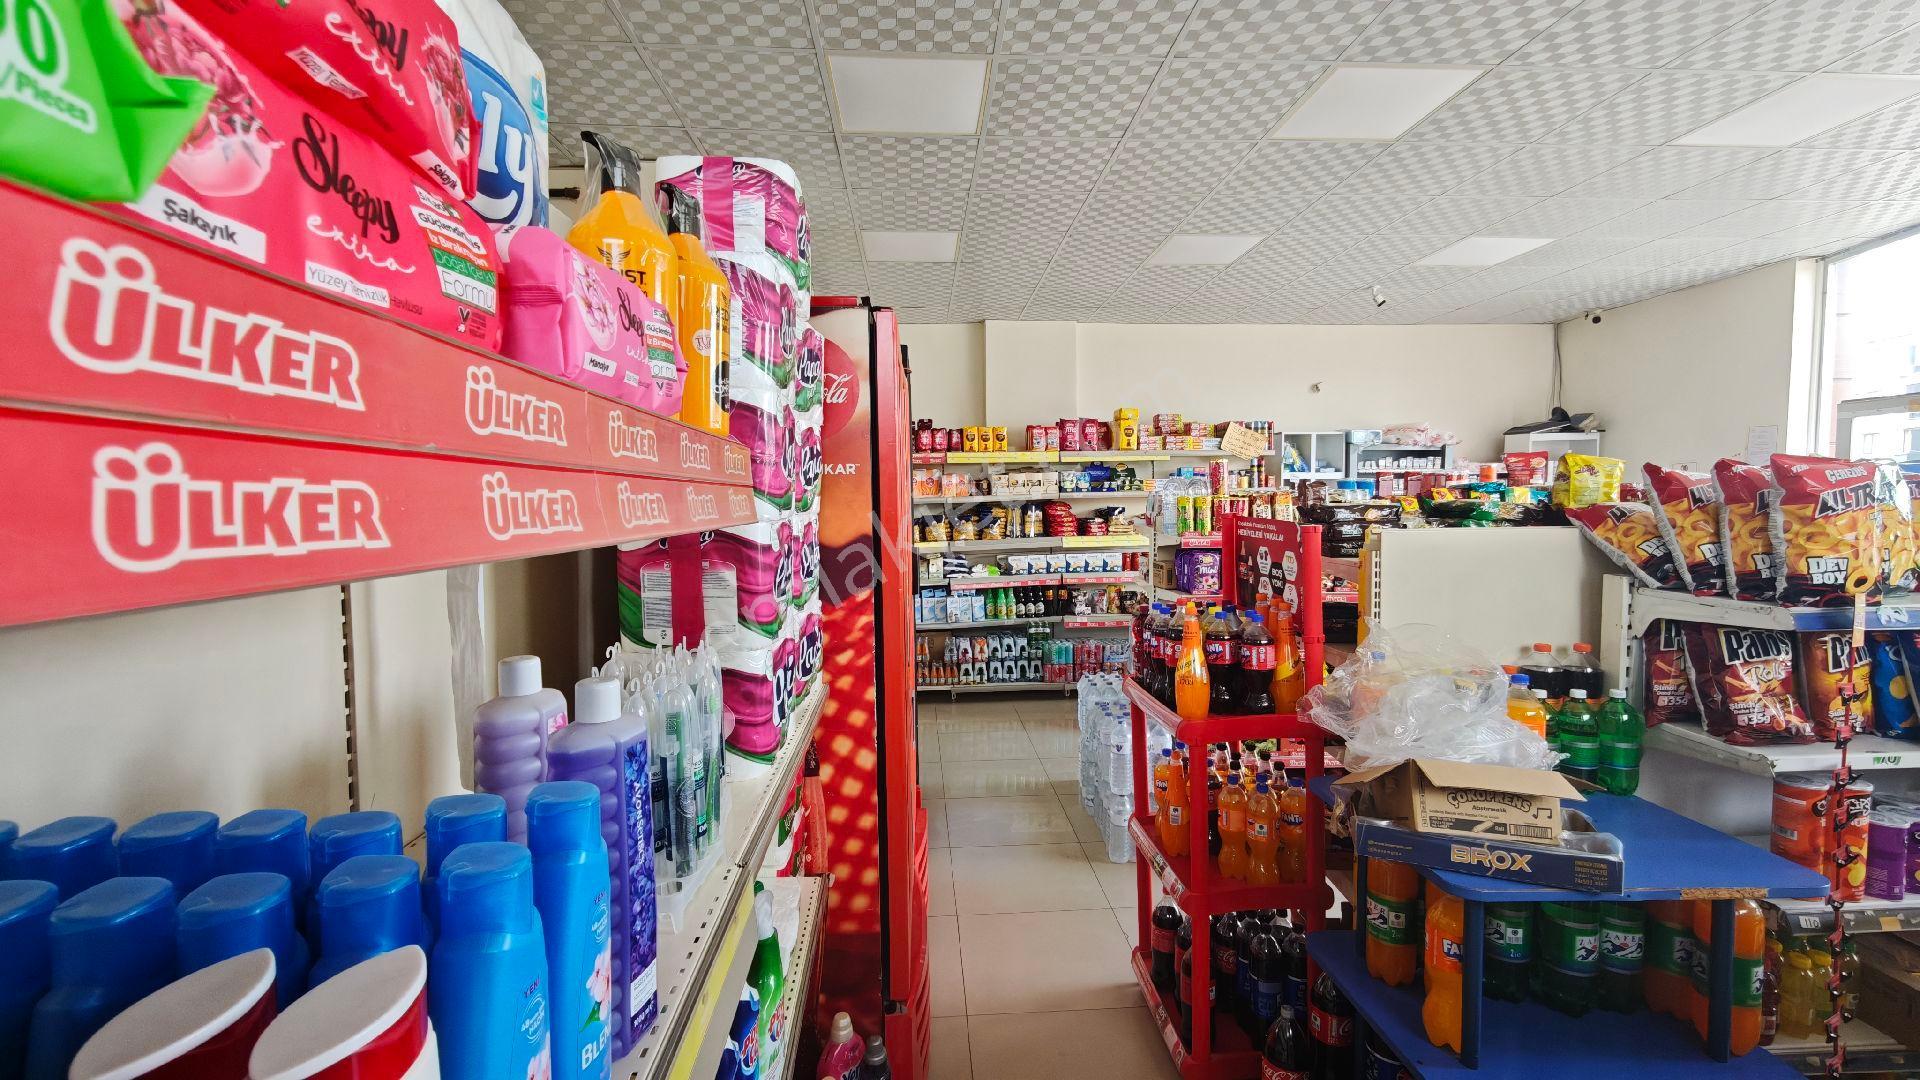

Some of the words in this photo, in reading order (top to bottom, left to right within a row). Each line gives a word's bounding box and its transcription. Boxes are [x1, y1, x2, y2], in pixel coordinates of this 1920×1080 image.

[293, 112, 401, 244] Sleepy
[162, 198, 239, 245] Şakayık
[308, 265, 347, 293] Yüzey
[50, 238, 366, 411] ÜLKER
[465, 366, 567, 447] ÜLKER
[609, 410, 659, 462] ÜLKER
[680, 431, 711, 470] ÜLKER
[724, 445, 746, 476] ÜLKER
[92, 442, 391, 573] ÜLKER
[482, 471, 583, 541] ÜLKER
[618, 481, 669, 528] ÜLKER
[687, 487, 719, 524] ÜLKER
[1807, 557, 1848, 573] DEV
[1812, 571, 1847, 584] BOY
[1717, 628, 1793, 666] Patos
[1450, 843, 1533, 873] BROX
